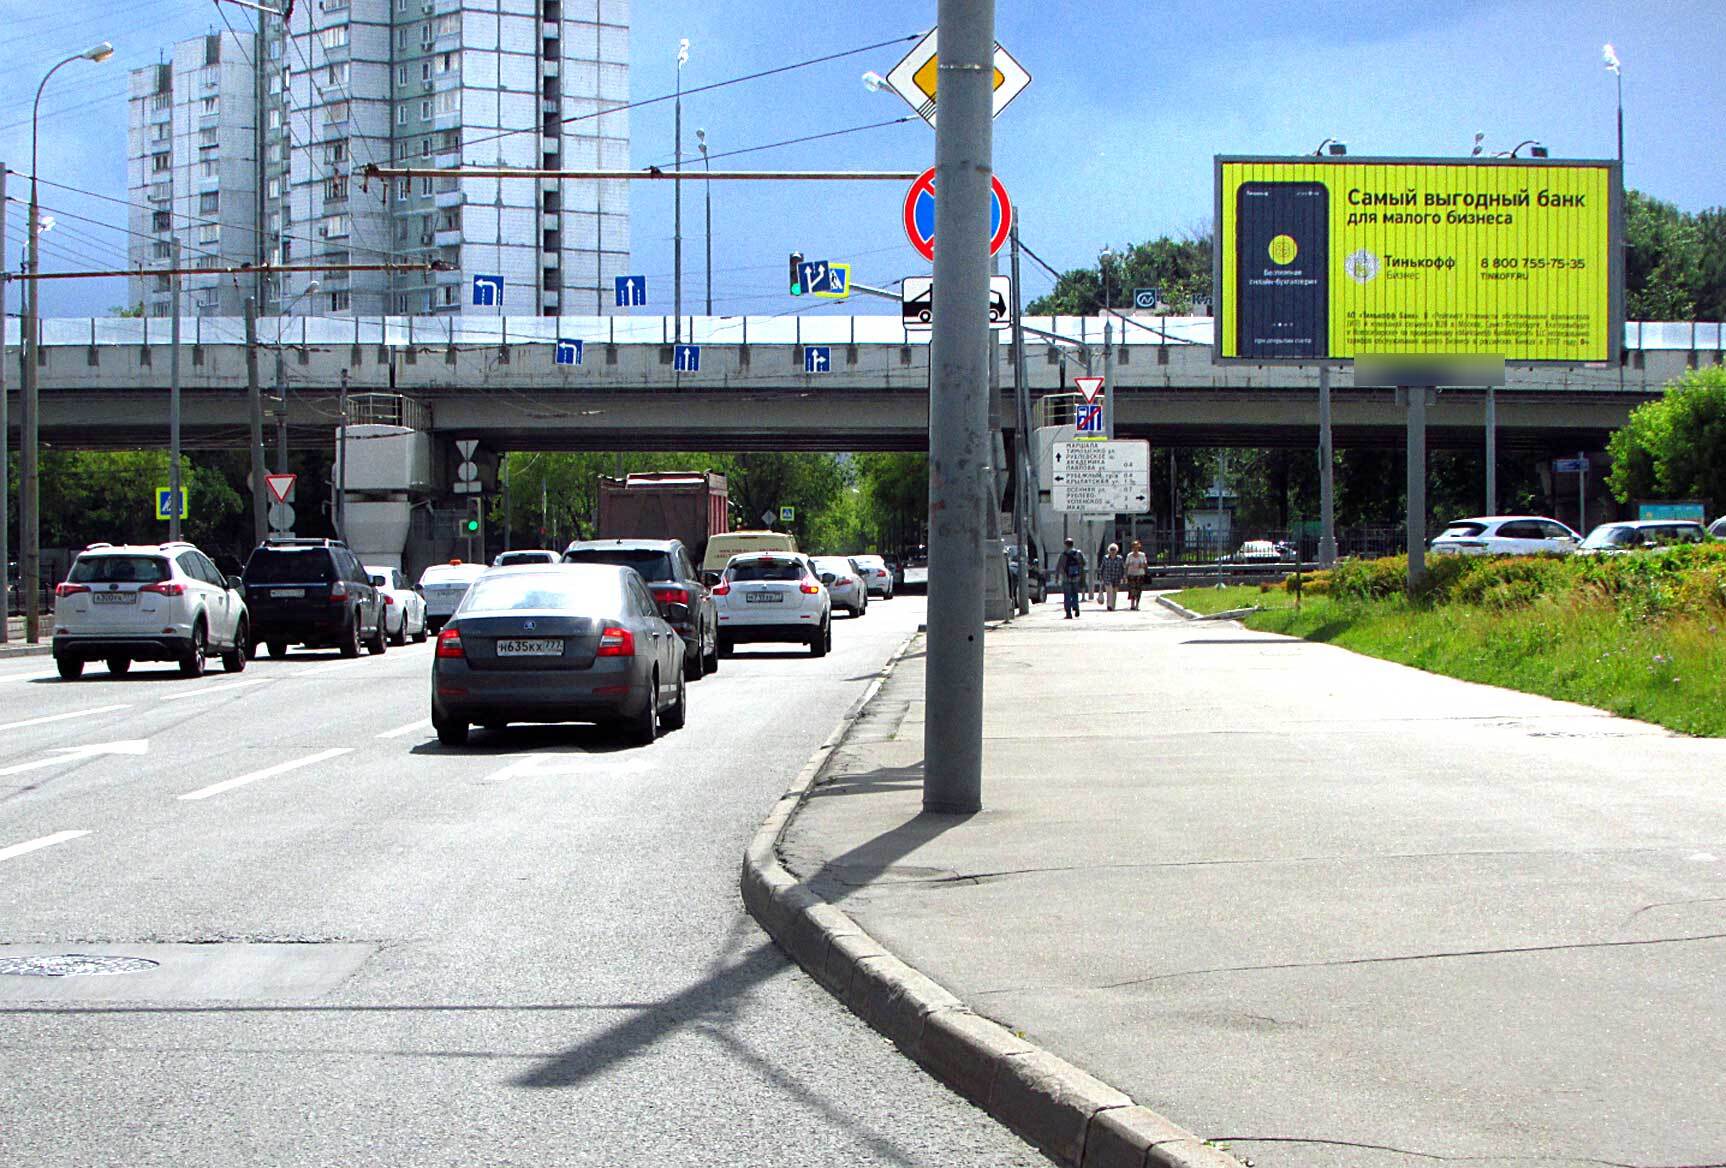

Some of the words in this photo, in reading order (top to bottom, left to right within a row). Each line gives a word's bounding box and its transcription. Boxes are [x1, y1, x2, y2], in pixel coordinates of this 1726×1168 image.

[1347, 188, 1418, 206] Самый
[1424, 189, 1530, 209] выгодный
[1537, 189, 1585, 207] банк
[1347, 211, 1377, 226] для
[1383, 212, 1441, 225] малого
[1447, 210, 1513, 225] бизнеса
[1384, 255, 1456, 271] Тинькофф
[1480, 258, 1489, 269] 8
[1493, 258, 1518, 269] 800
[1522, 258, 1585, 269] 755-75-35
[1386, 271, 1420, 280] Бизнес
